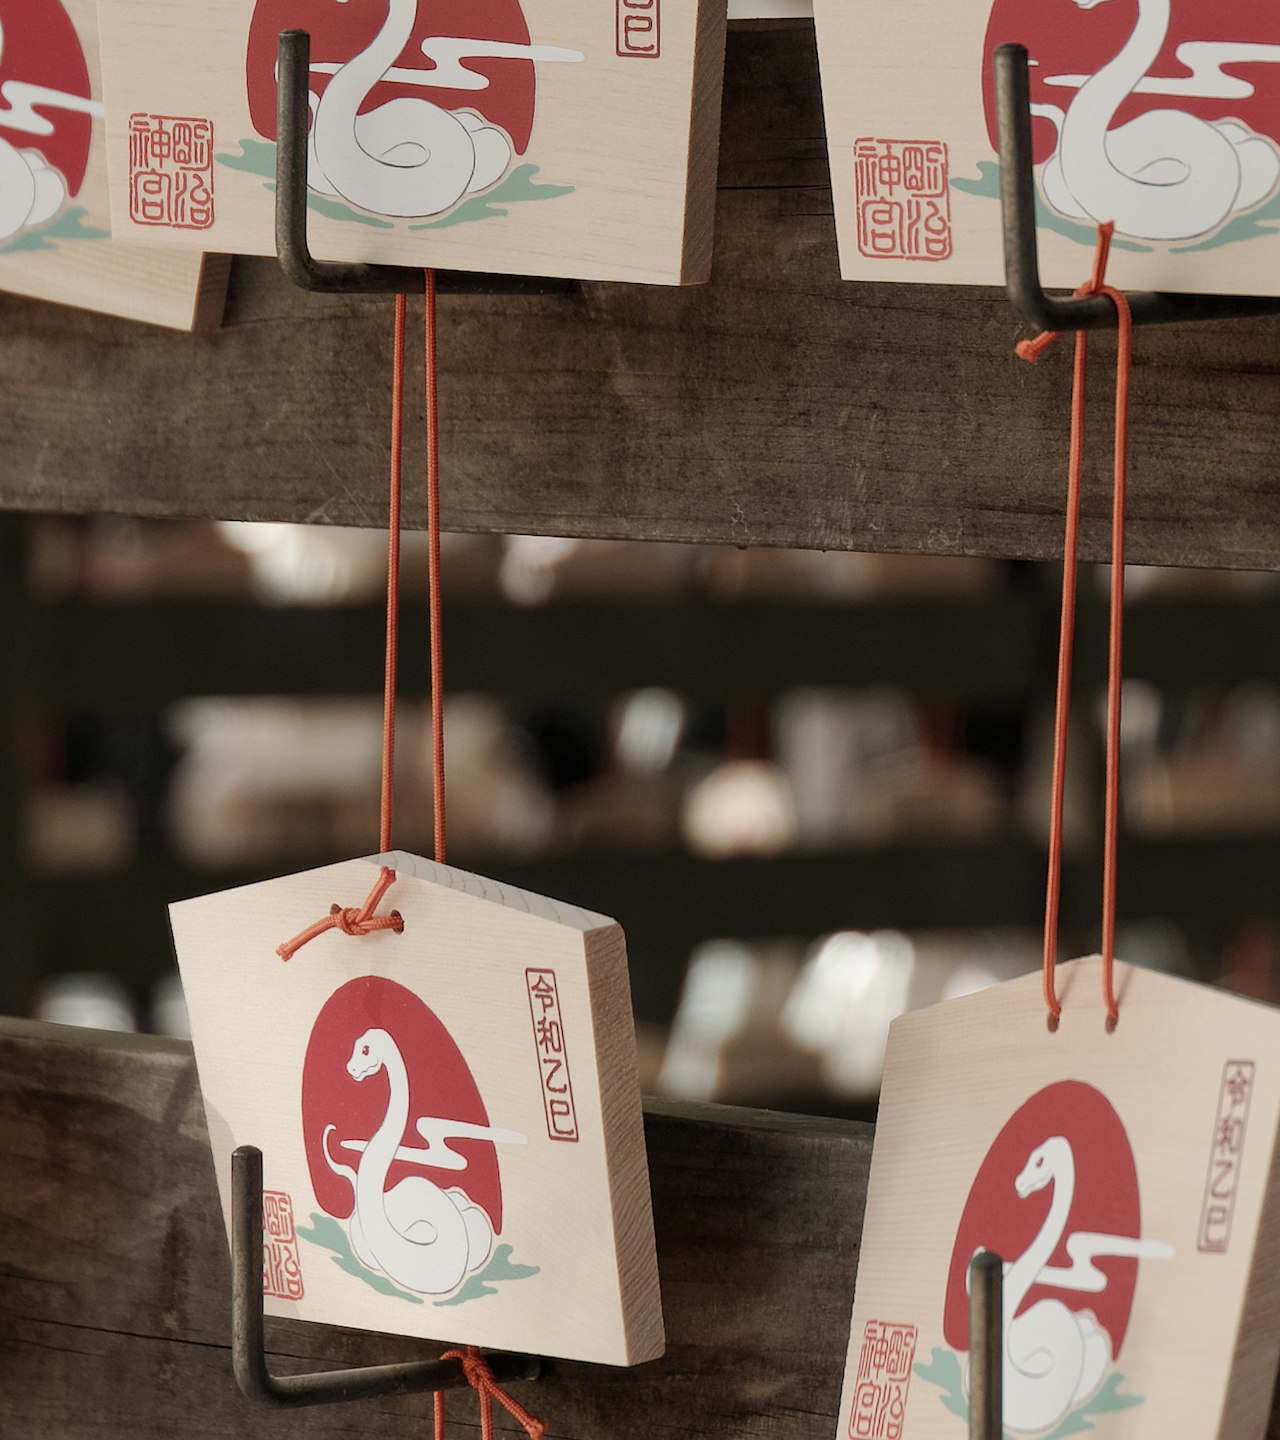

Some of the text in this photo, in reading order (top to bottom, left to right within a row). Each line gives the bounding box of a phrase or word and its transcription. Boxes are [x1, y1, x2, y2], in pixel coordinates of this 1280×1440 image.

[531, 974, 574, 1136] 令和乙巳
[1205, 1068, 1248, 1245] 令和乙巳
